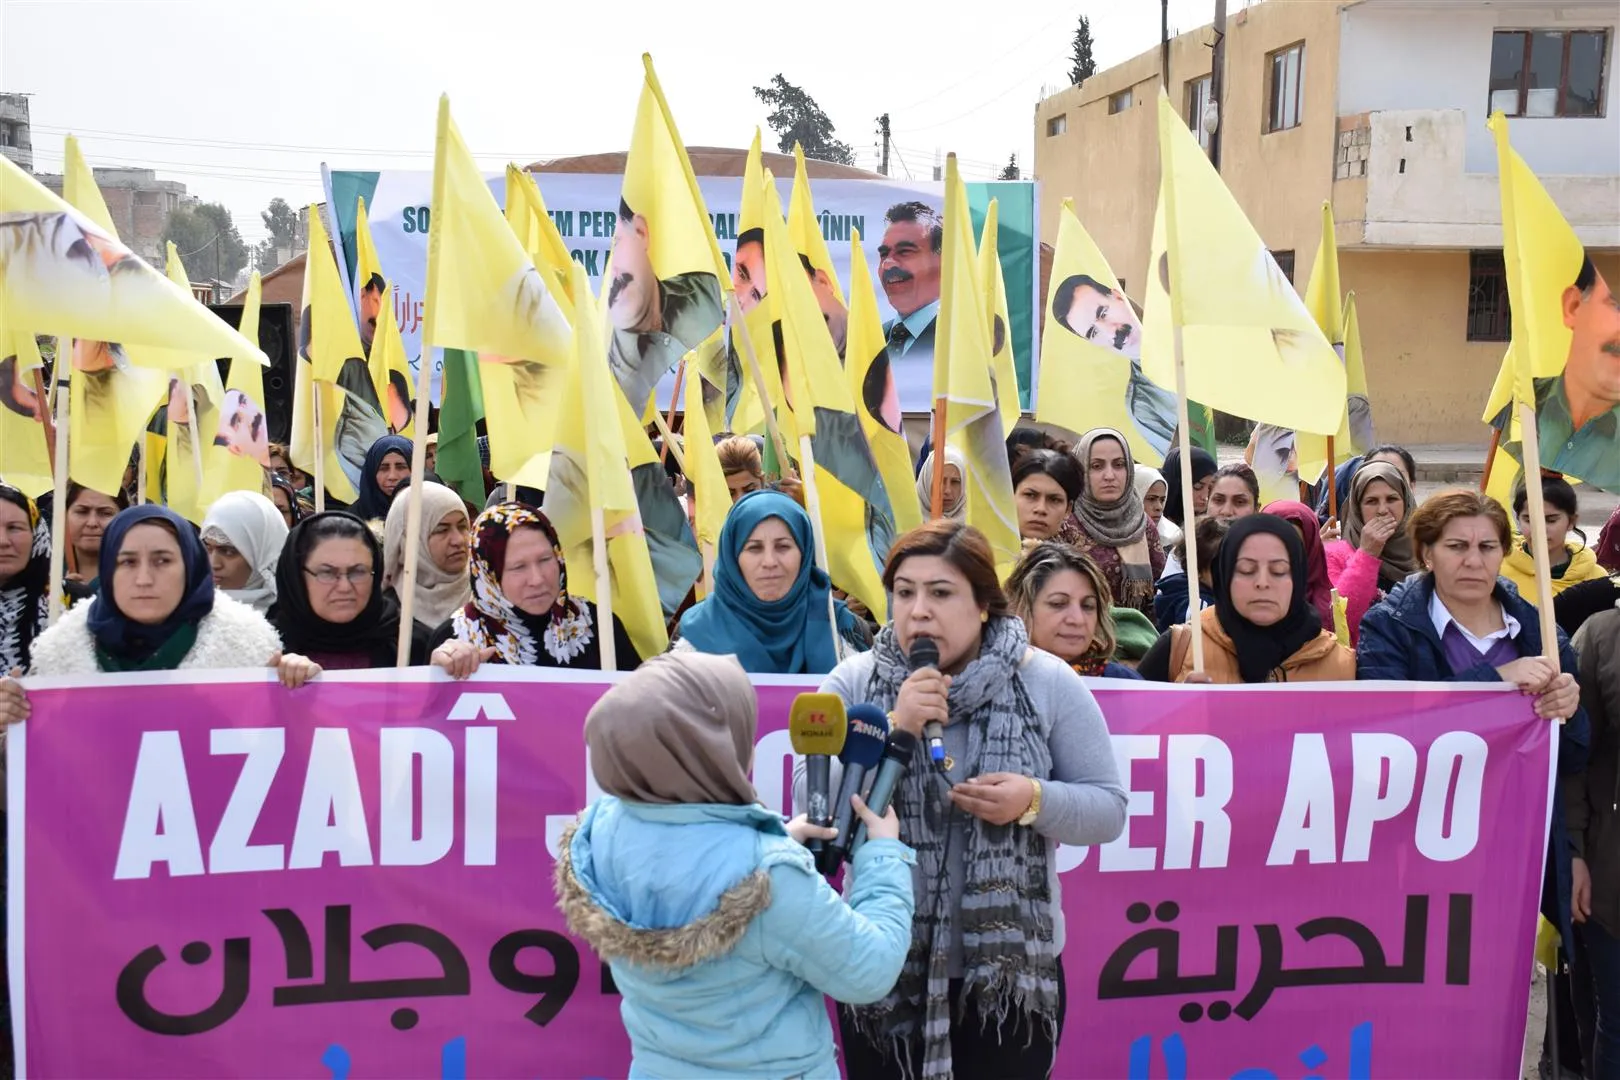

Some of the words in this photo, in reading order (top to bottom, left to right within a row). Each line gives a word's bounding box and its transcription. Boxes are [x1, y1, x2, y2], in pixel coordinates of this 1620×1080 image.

[402, 206, 430, 233] SO
[579, 211, 616, 238] PER
[816, 209, 865, 241] ÎNIN
[114, 692, 516, 880] AZADÎ
[1265, 730, 1489, 867] APO
[116, 904, 624, 1036] وجلان
[1097, 893, 1473, 1023] الحرية
